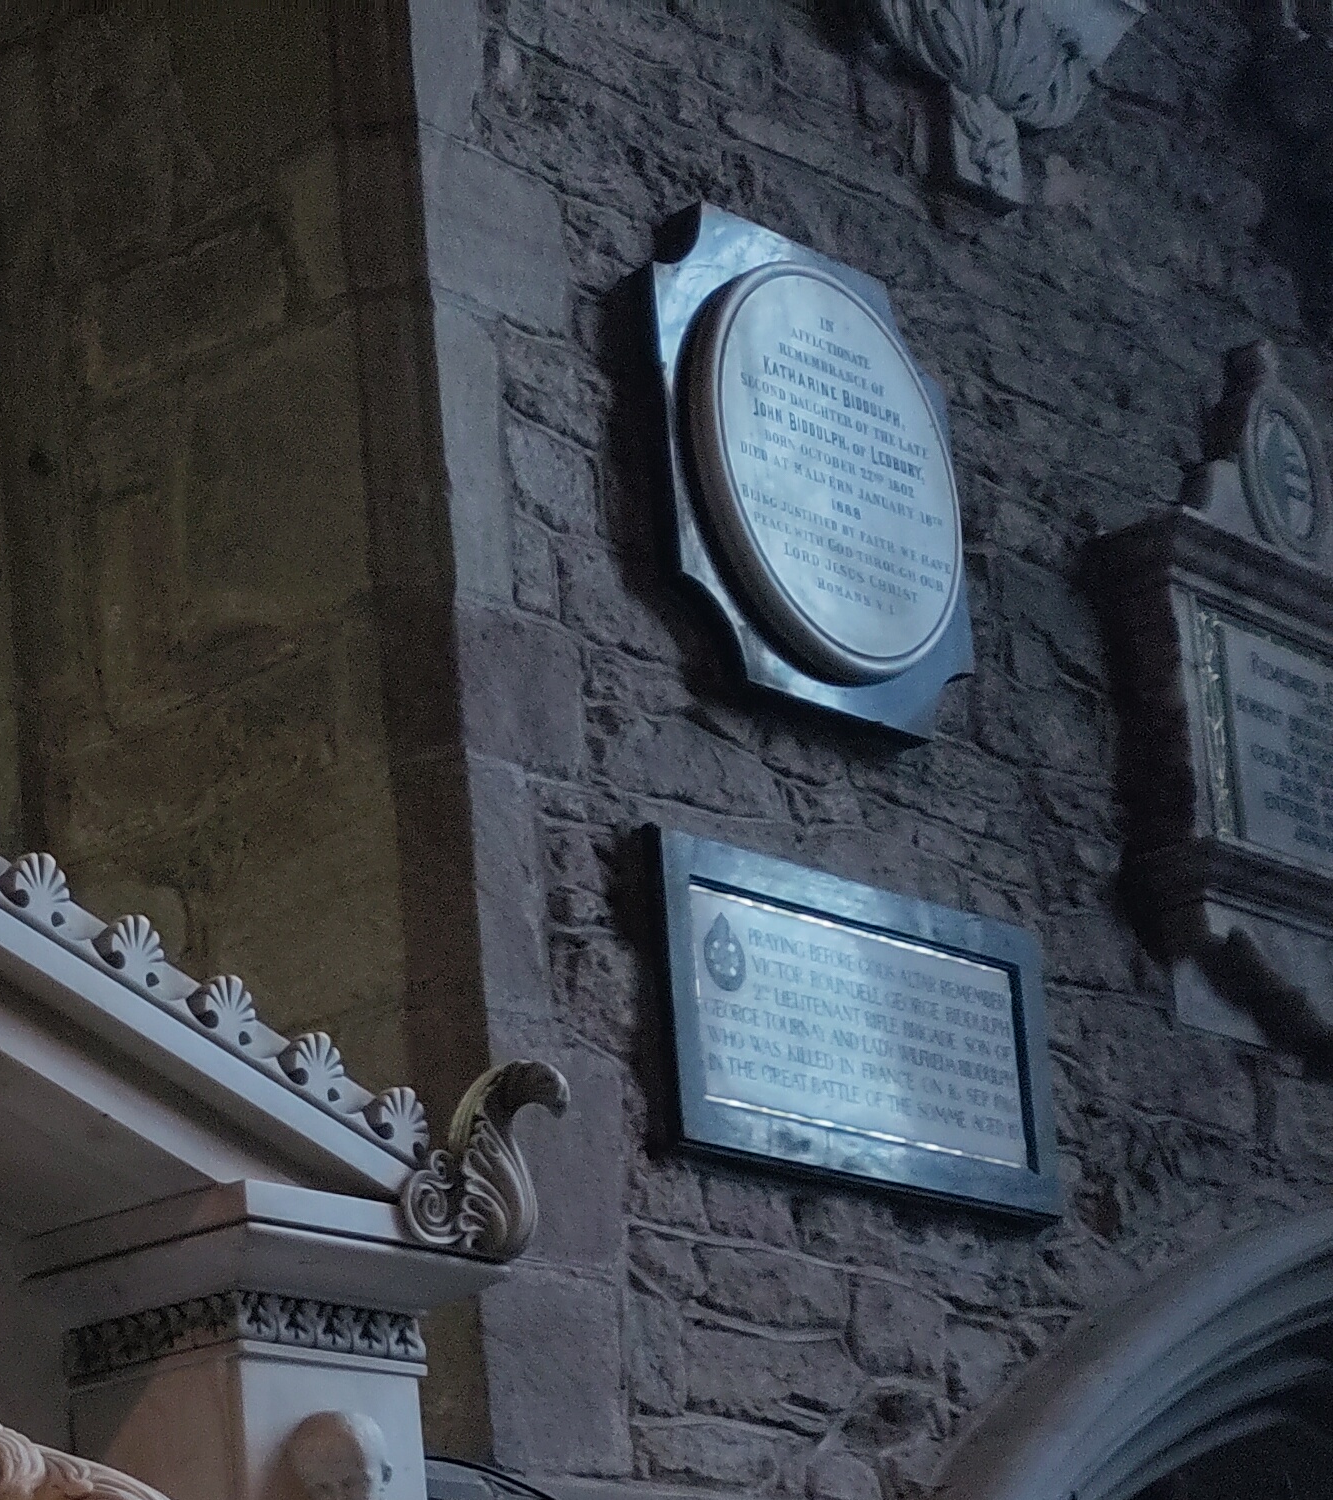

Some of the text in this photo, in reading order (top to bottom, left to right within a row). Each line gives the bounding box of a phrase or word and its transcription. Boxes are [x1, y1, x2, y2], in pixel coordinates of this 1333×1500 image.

[819, 316, 835, 332] IN
[778, 341, 885, 397] REMEMBRANCE OF
[790, 326, 872, 371] AFFECTIONATE
[762, 355, 837, 401] KATHARINE
[740, 371, 896, 446] SECOND DAUGHTER OF THE
[753, 397, 783, 424] JOHN
[740, 440, 915, 519] DIED MALVERN JANUARY
[800, 443, 857, 476] OCTOBER
[868, 574, 919, 604] CHRIST
